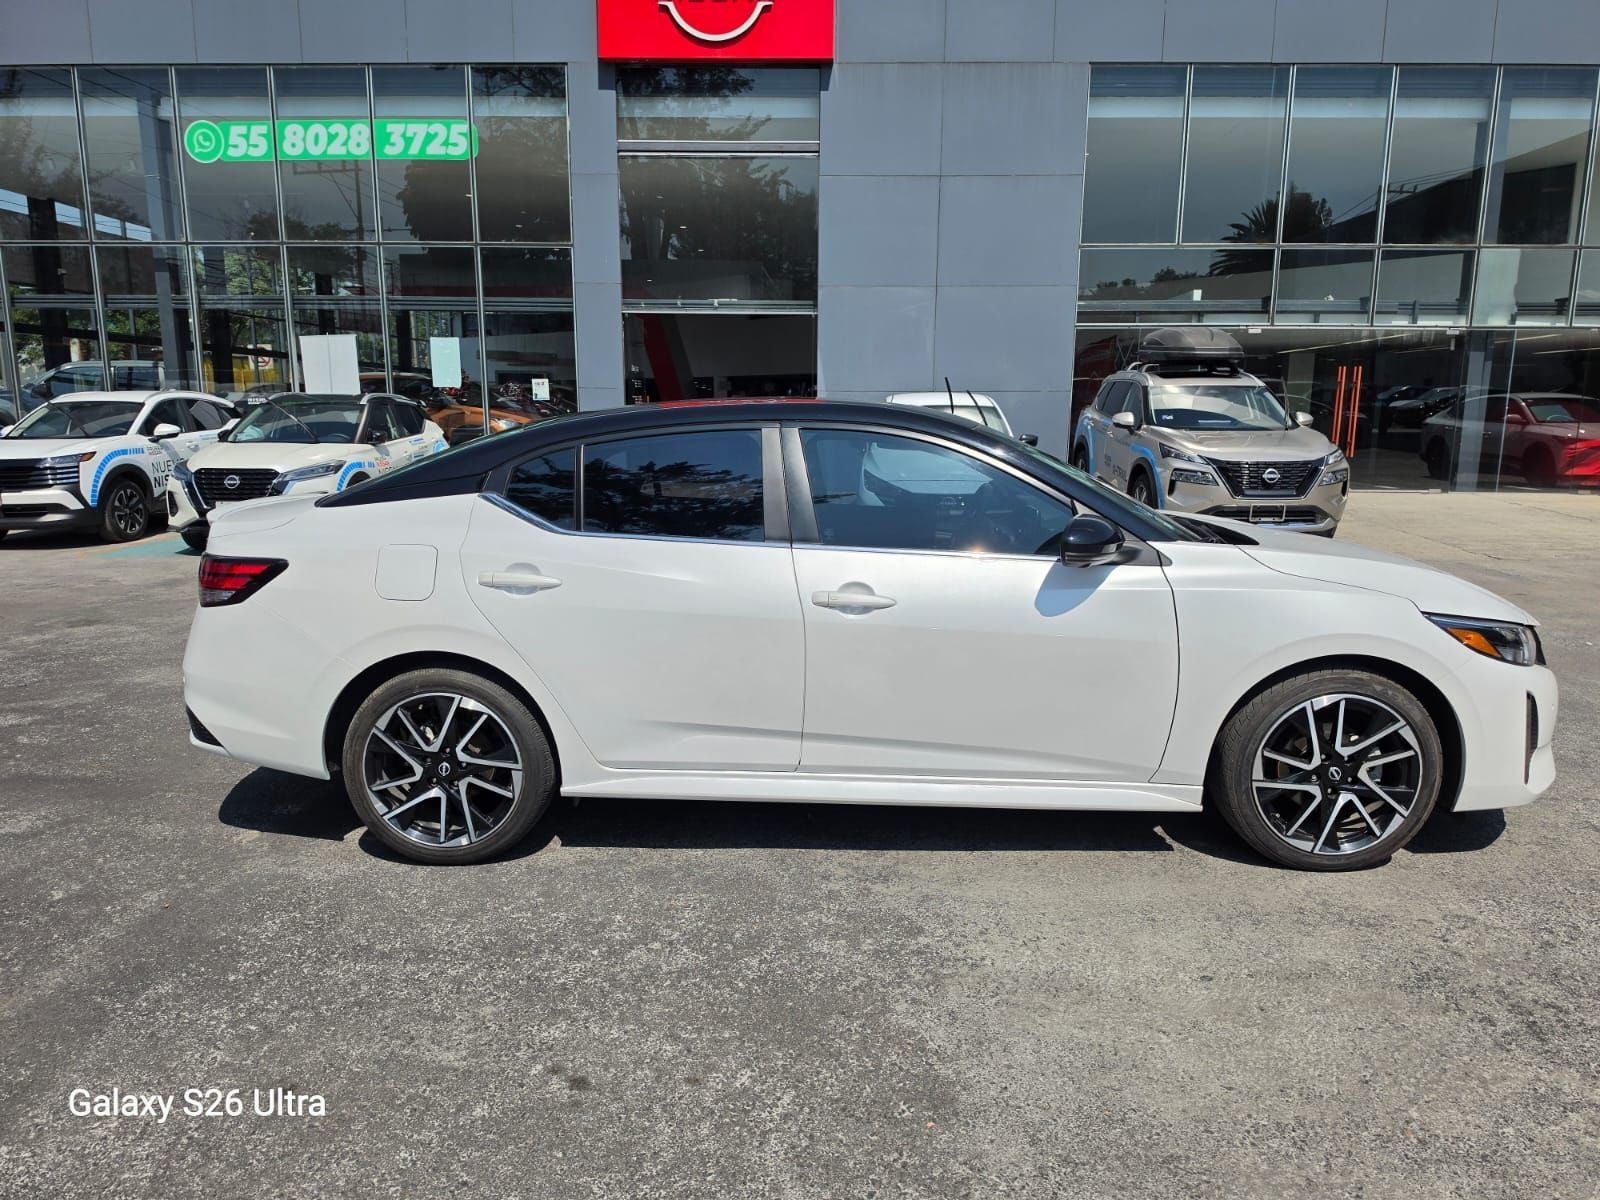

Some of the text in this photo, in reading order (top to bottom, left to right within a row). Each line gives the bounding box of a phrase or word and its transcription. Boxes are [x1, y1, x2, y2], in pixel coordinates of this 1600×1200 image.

[227, 123, 467, 157] 55 8028 3725
